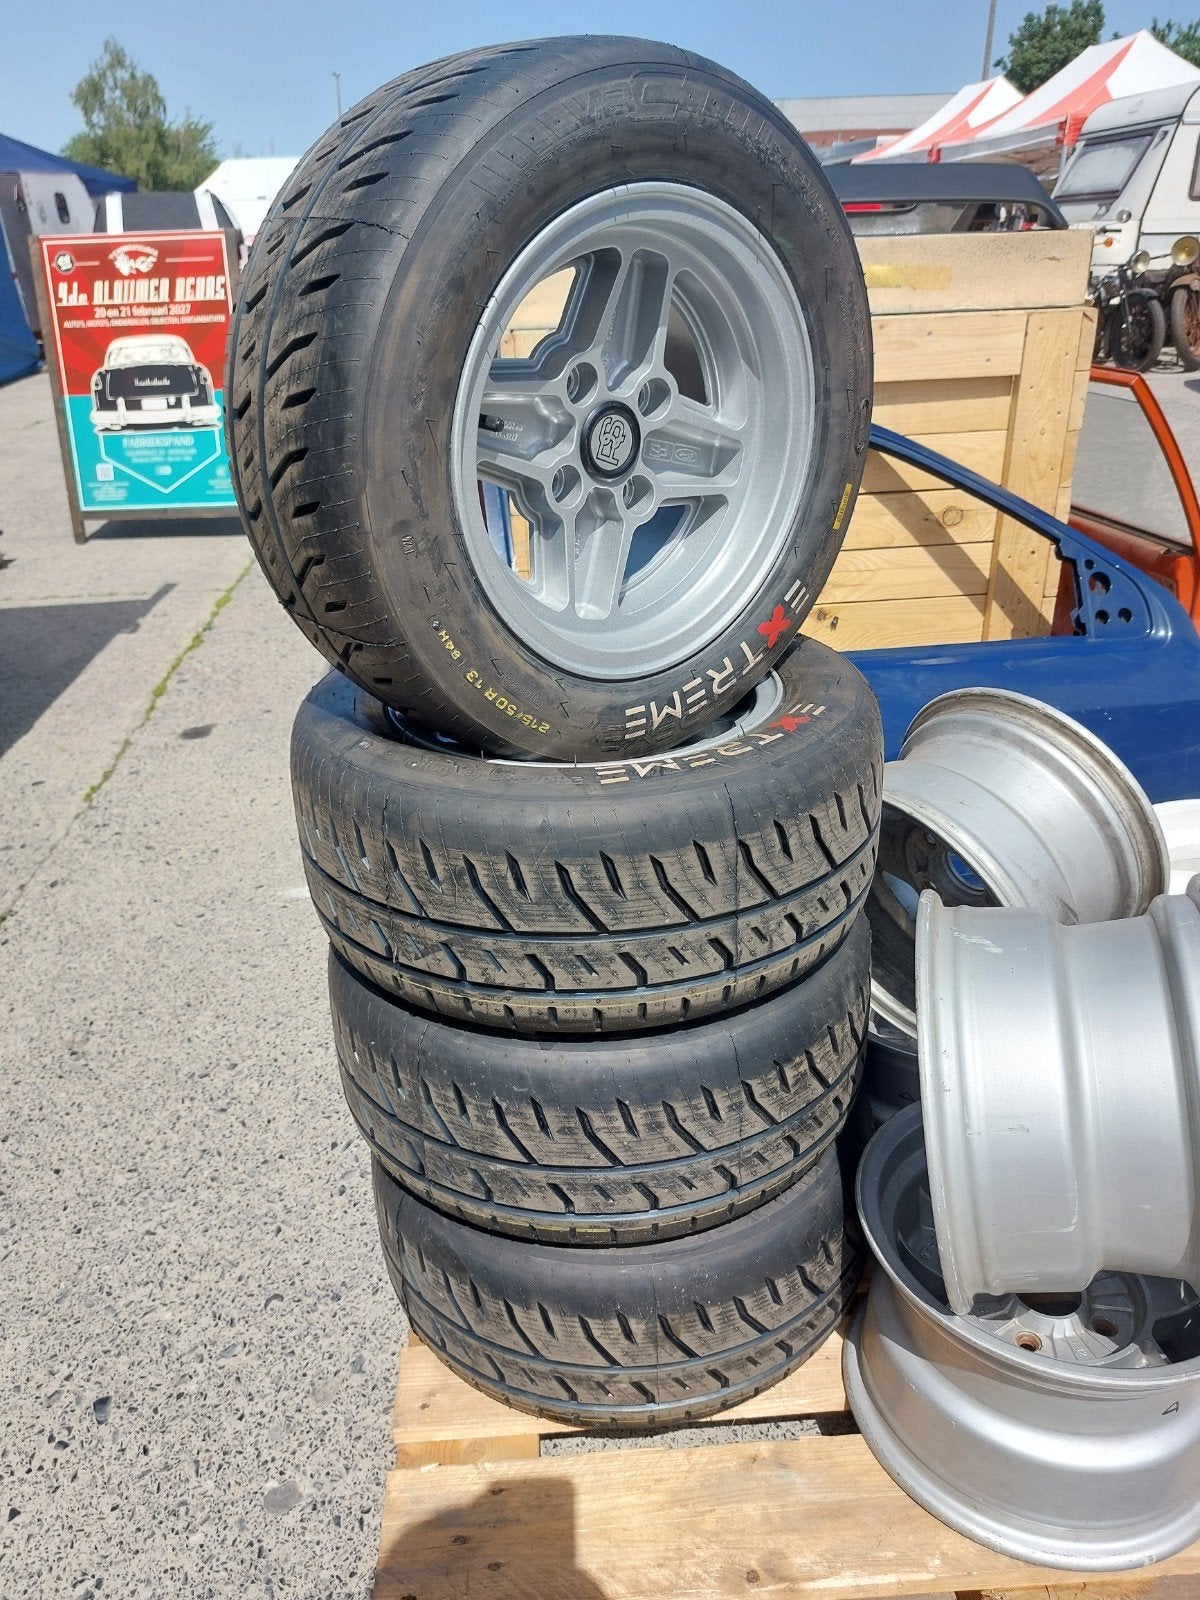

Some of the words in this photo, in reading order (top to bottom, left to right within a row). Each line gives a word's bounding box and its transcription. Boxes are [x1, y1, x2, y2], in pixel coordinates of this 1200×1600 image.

[94, 306, 107, 318] 20
[107, 308, 120, 318] en
[120, 306, 131, 317] 21
[132, 305, 168, 317] februari
[596, 417, 626, 466] RS
[465, 668, 483, 689] 13
[624, 579, 810, 740] EXTREME
[594, 703, 826, 785] EXTREME
